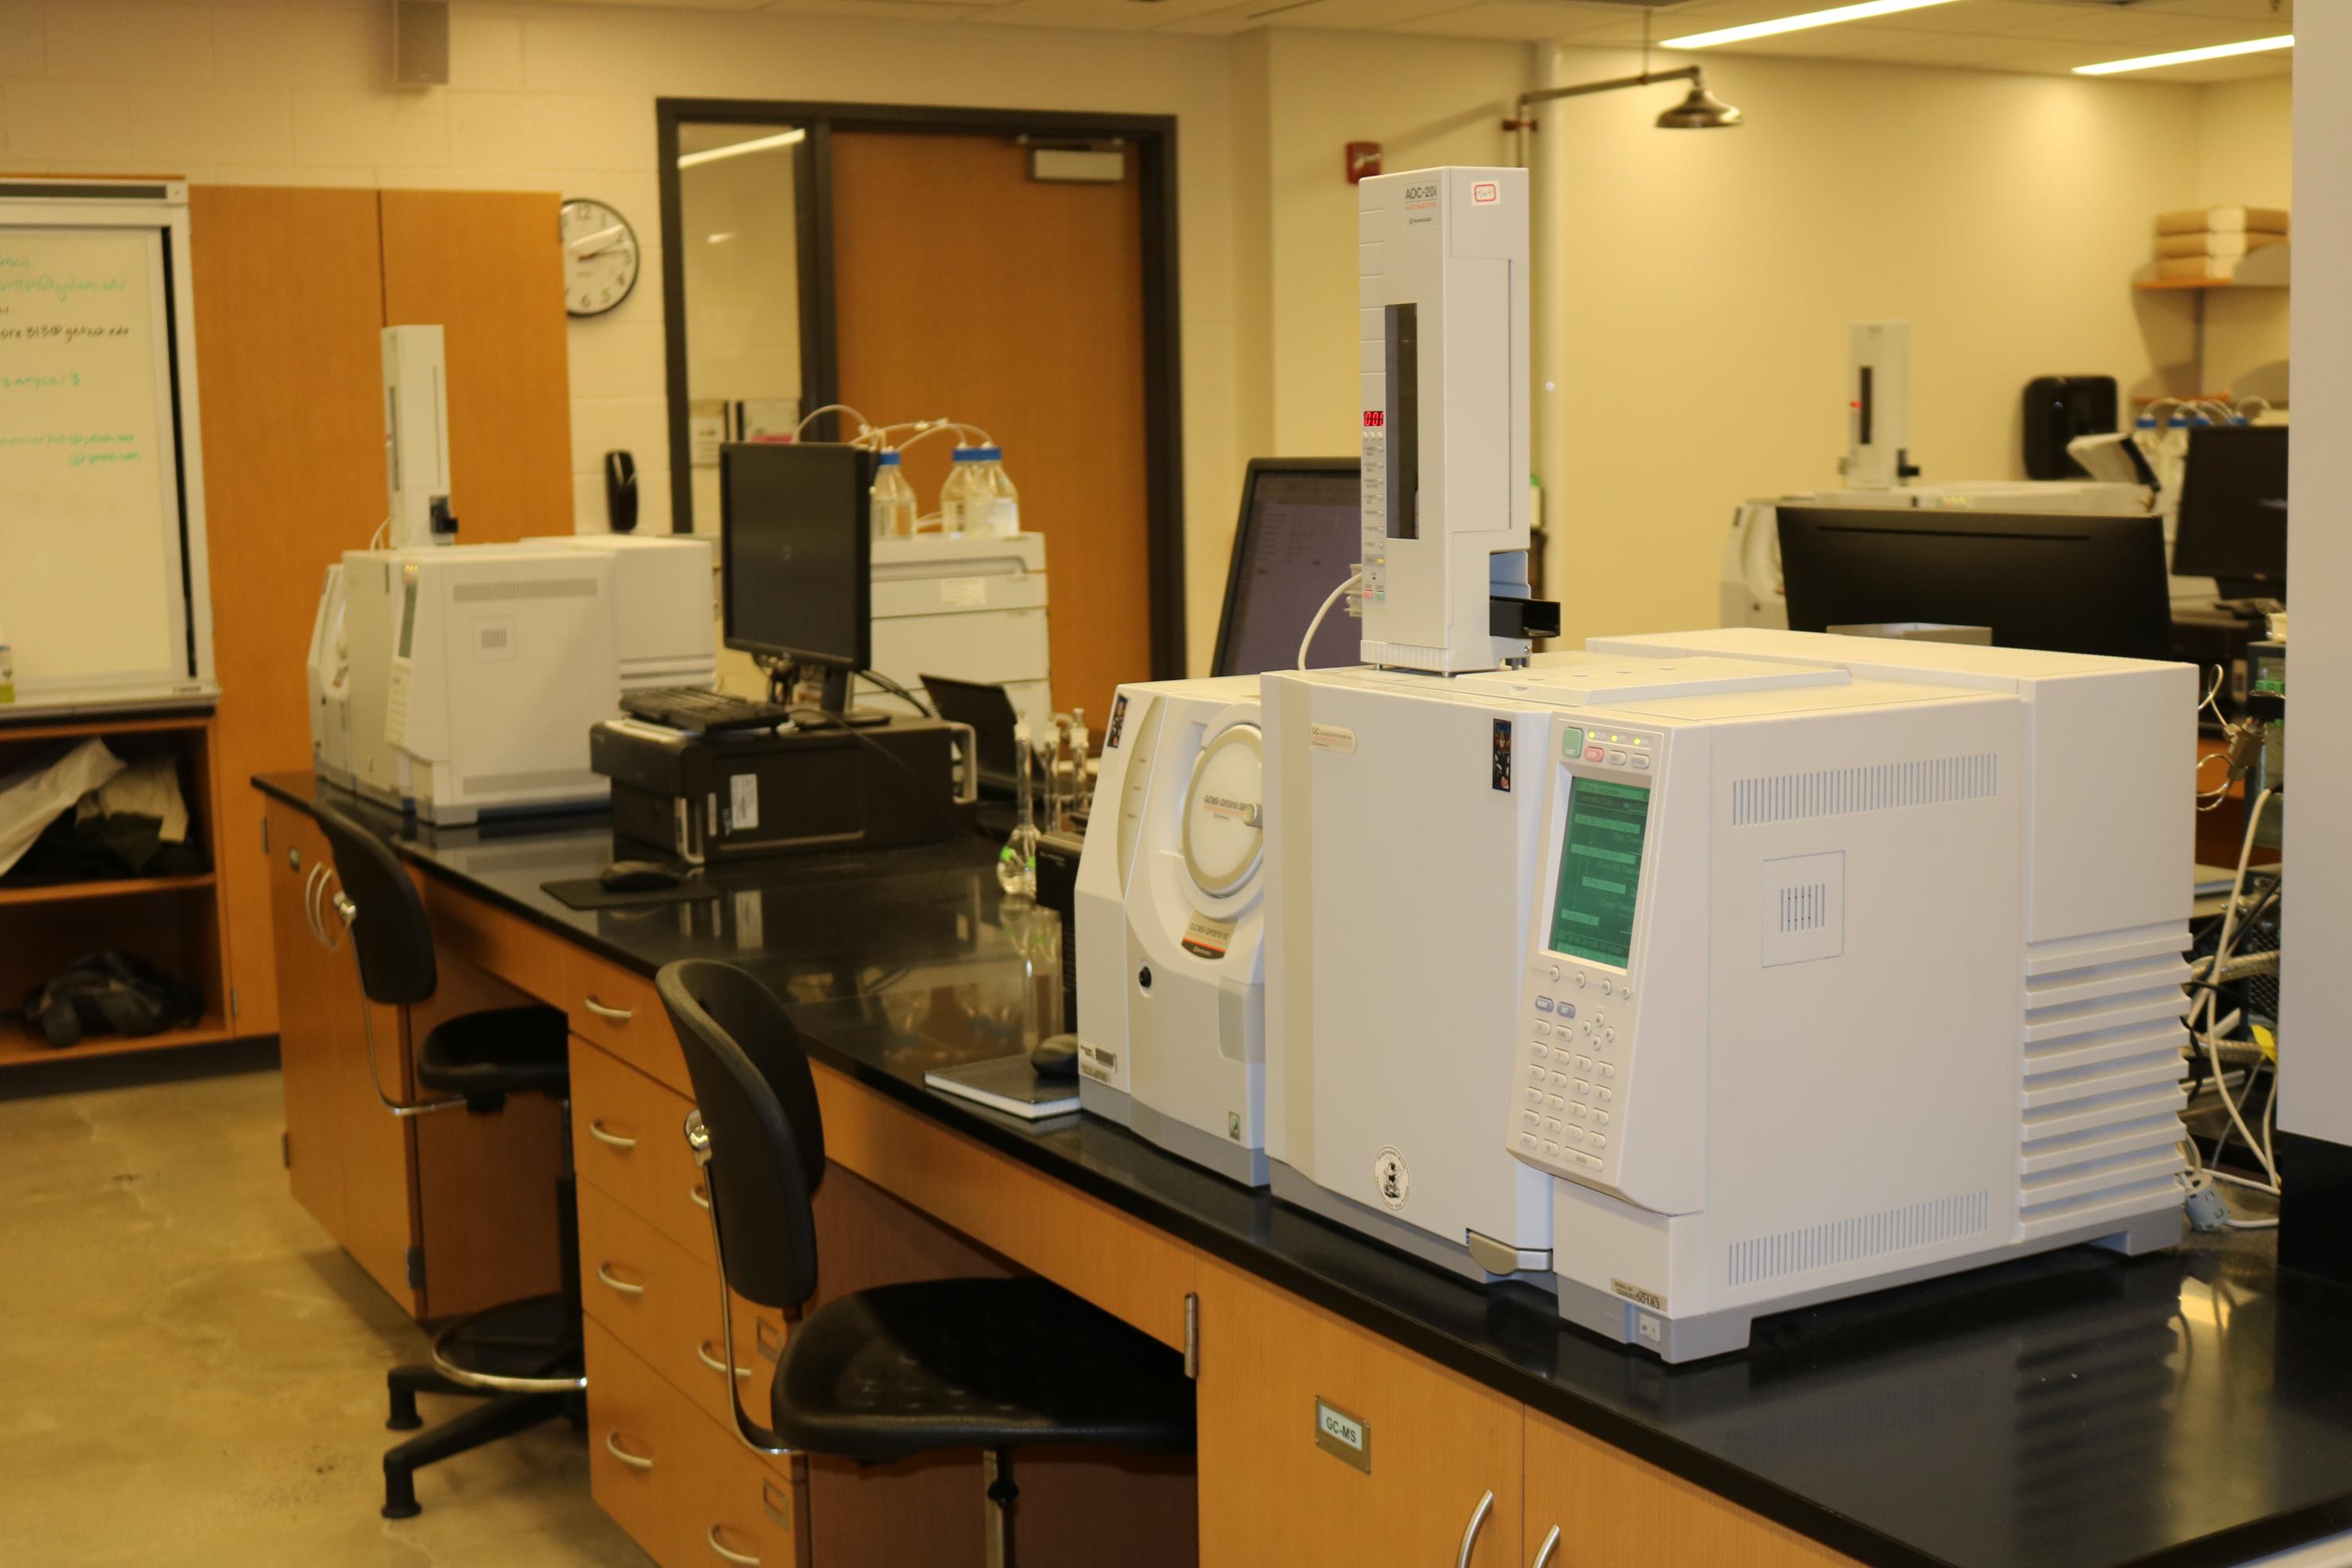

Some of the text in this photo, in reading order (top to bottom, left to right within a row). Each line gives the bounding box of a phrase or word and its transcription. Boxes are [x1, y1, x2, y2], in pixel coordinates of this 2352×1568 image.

[576, 204, 592, 220] 12
[617, 272, 625, 285] 4
[581, 293, 591, 307] 6
[601, 288, 610, 303] 5
[1327, 1417, 1356, 1443] GC-MS
